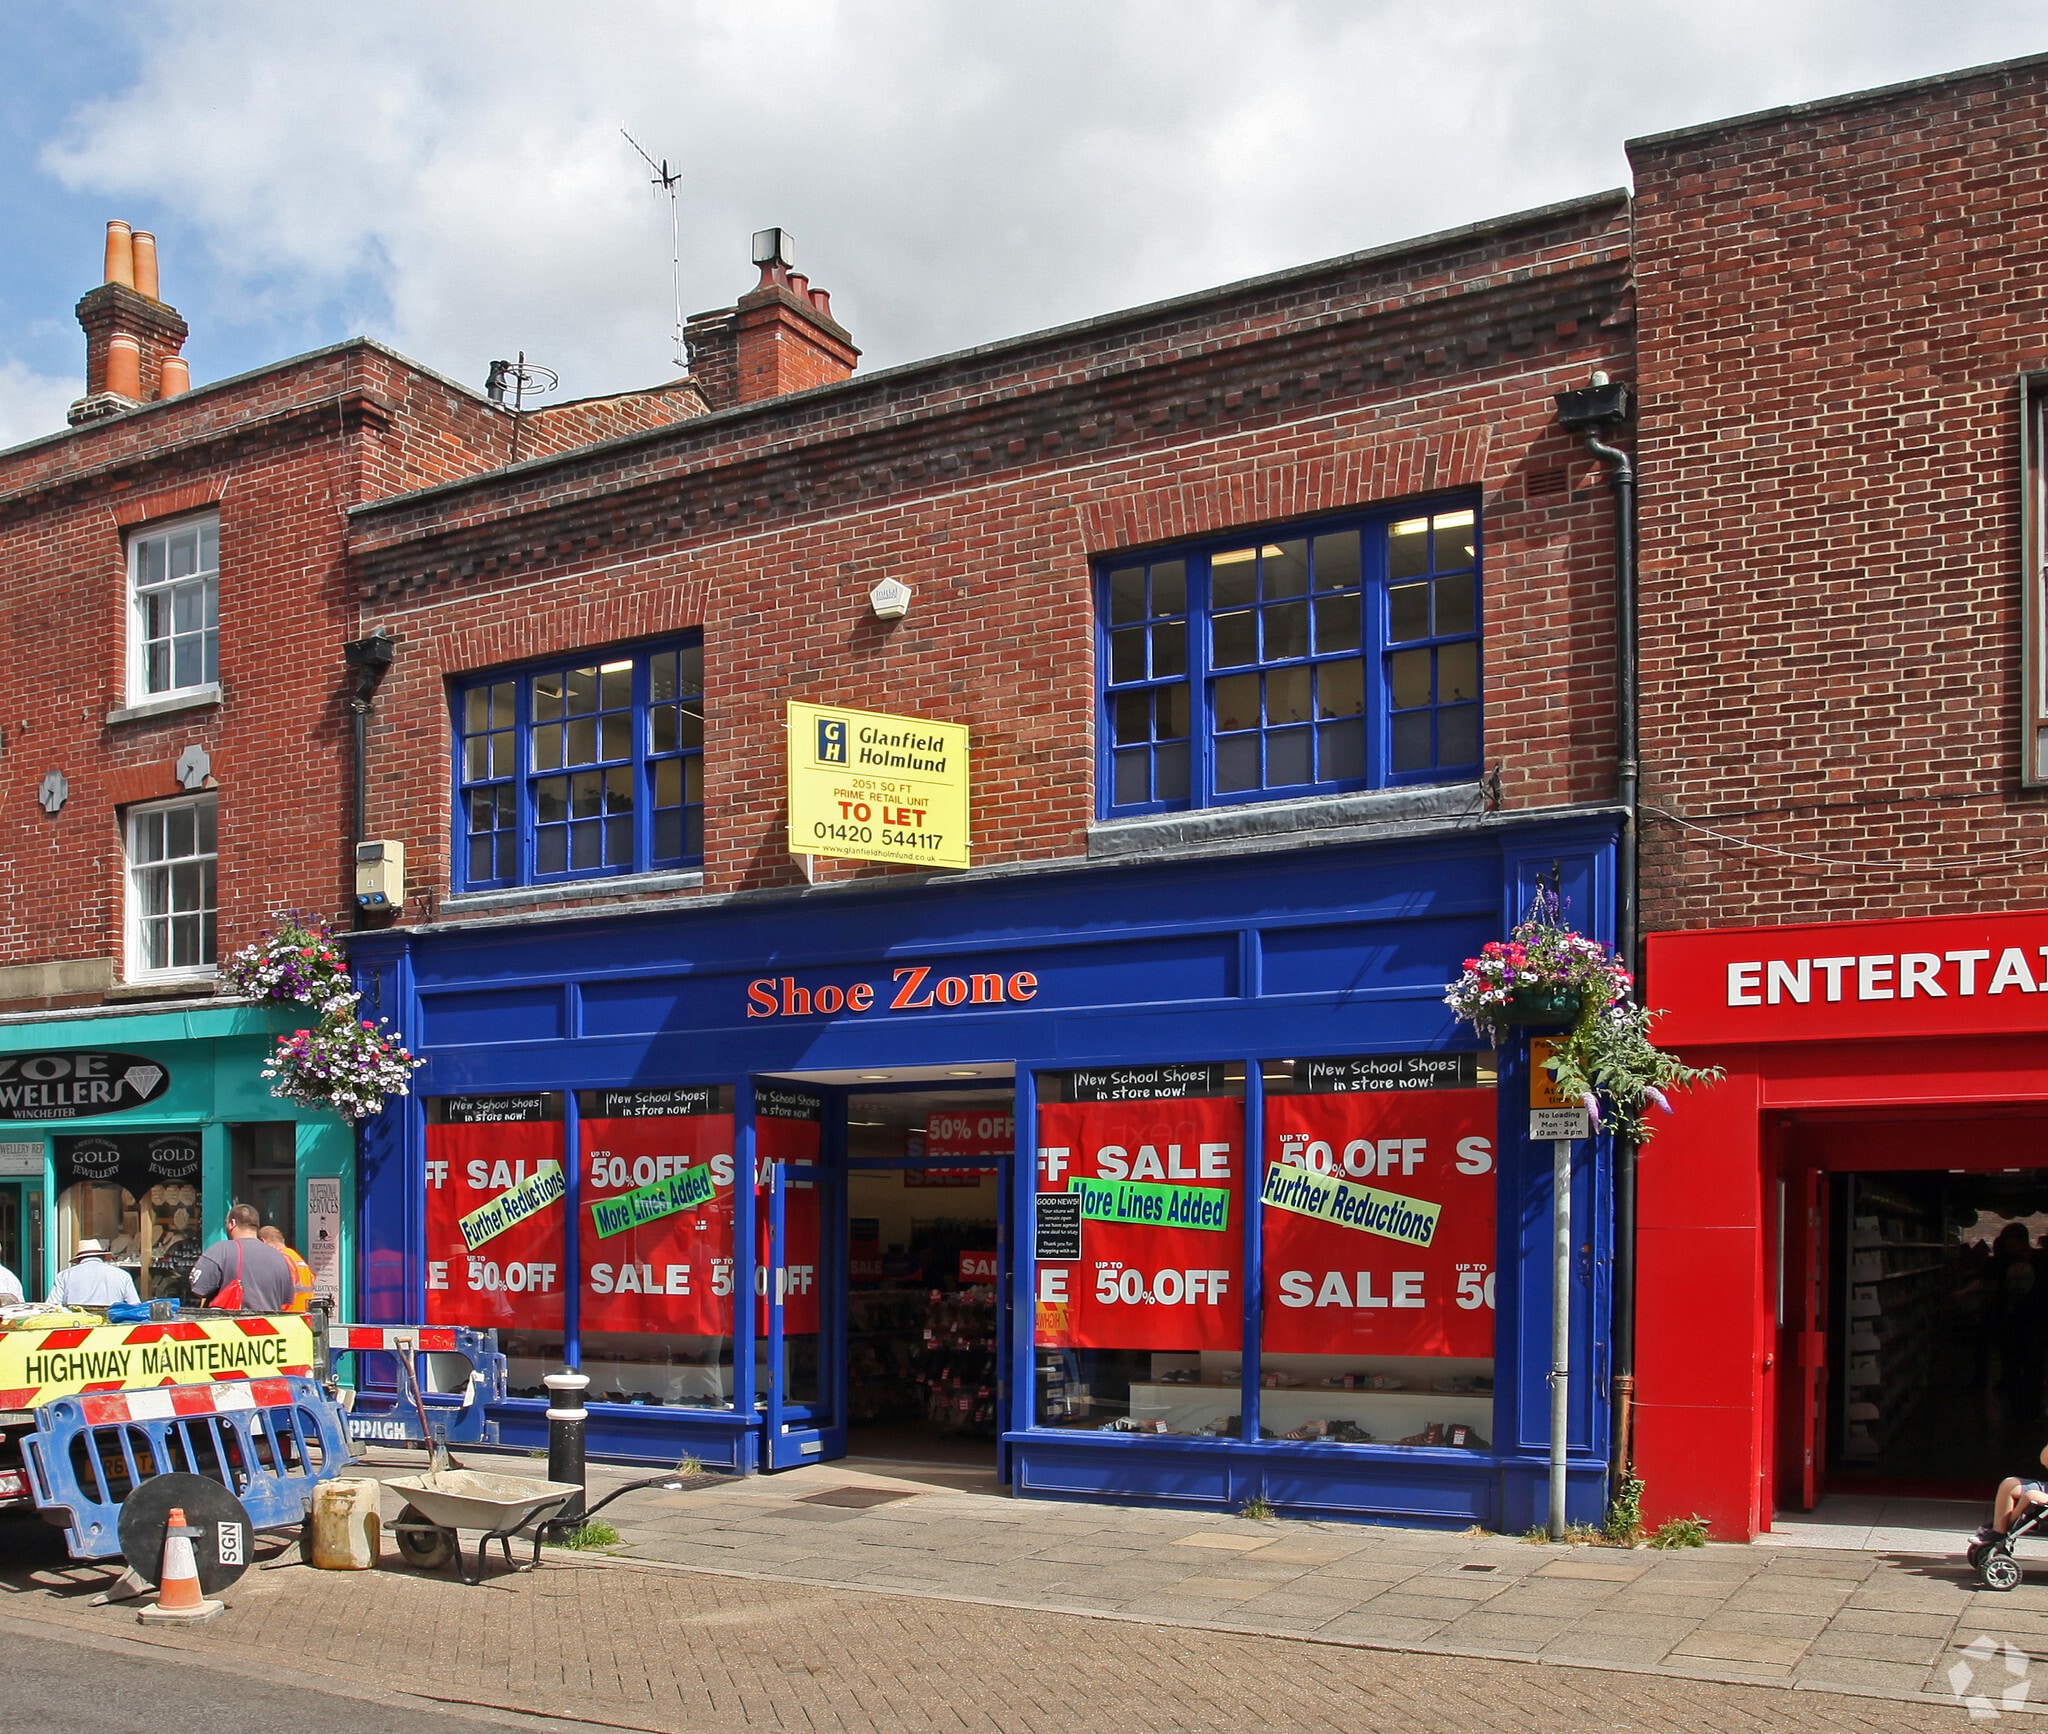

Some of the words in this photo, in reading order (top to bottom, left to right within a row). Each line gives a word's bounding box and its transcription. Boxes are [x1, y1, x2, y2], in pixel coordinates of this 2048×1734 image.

[859, 726, 944, 753] Glanfield
[859, 747, 946, 773] Holmlund
[852, 778, 876, 790] 2051
[880, 782, 895, 792] SQ
[899, 784, 912, 794] FT
[834, 788, 865, 801] PRIME
[869, 791, 903, 805] RETAIL
[906, 797, 929, 807] UNIT
[838, 801, 872, 822] TO
[883, 805, 927, 828] LET
[814, 821, 872, 843] 01420
[881, 829, 943, 850] 544117
[822, 845, 936, 863] www.glanfieldholmlund.co.uk
[747, 976, 874, 1018] Shoe
[889, 966, 1038, 1011] Zone
[1313, 1062, 1346, 1077] New
[1351, 1060, 1403, 1075] School
[1408, 1058, 1457, 1073] Shoes
[1077, 1073, 1108, 1086] New
[1110, 1070, 1158, 1085] School
[1165, 1069, 1206, 1082] Shoes
[1333, 1077, 1346, 1092] in
[1350, 1075, 1394, 1091] store
[1399, 1073, 1435, 1089] now!
[609, 1093, 632, 1105] New
[635, 1091, 671, 1104] School
[674, 1089, 706, 1101] Shoes
[769, 1091, 796, 1105] School
[797, 1094, 821, 1107] Shoes
[1096, 1087, 1108, 1100] in
[1112, 1084, 1151, 1099] store
[1154, 1083, 1187, 1098] now!
[13, 1107, 76, 1119] WINCHESTER
[452, 1100, 473, 1110] New
[476, 1099, 509, 1111] School
[512, 1097, 540, 1108] Shoes
[622, 1106, 632, 1117] in
[635, 1104, 664, 1116] store
[667, 1102, 691, 1115] now!
[769, 1103, 792, 1117] store
[793, 1108, 810, 1119] now!
[464, 1114, 473, 1122] in
[475, 1110, 502, 1122] store
[504, 1110, 527, 1121] now!
[1552, 1111, 1580, 1120] loading
[1564, 1120, 1578, 1128] Sat
[928, 1118, 972, 1140] 50%
[977, 1117, 1015, 1139] OFF
[1279, 1134, 1294, 1142] UP
[1295, 1133, 1310, 1142] TO
[72, 1151, 120, 1164] GOLD
[152, 1149, 196, 1162] GOLD
[1096, 1142, 1231, 1181] SALE
[1455, 1136, 1497, 1176] S
[72, 1164, 120, 1179] JEWELLERY
[149, 1161, 199, 1179] JEWELLERY
[309, 1196, 339, 1214] SERVICES
[461, 1206, 504, 1247] Further
[501, 1171, 566, 1223] Reductions
[596, 1204, 631, 1235] More
[631, 1192, 668, 1222] Lines
[669, 1168, 711, 1207] Added
[1037, 1198, 1057, 1206] GOOD
[1058, 1198, 1080, 1206] NEWS!
[1116, 1185, 1164, 1221] Lines
[1166, 1190, 1226, 1227] Added
[1264, 1167, 1330, 1214] Further
[1330, 1184, 1435, 1242] Reductions
[312, 1242, 335, 1250] REPAIRS
[850, 1260, 883, 1275] SALE
[1110, 1261, 1123, 1269] TO
[1456, 1263, 1470, 1272] UP
[1472, 1263, 1488, 1272] TO
[590, 1263, 691, 1296] SALE
[710, 1265, 735, 1297] 5
[1278, 1270, 1426, 1309] SALE
[25, 1349, 132, 1384] HIGHWAY
[142, 1338, 288, 1375] MAINTENANCE
[220, 1524, 238, 1562] SGN
